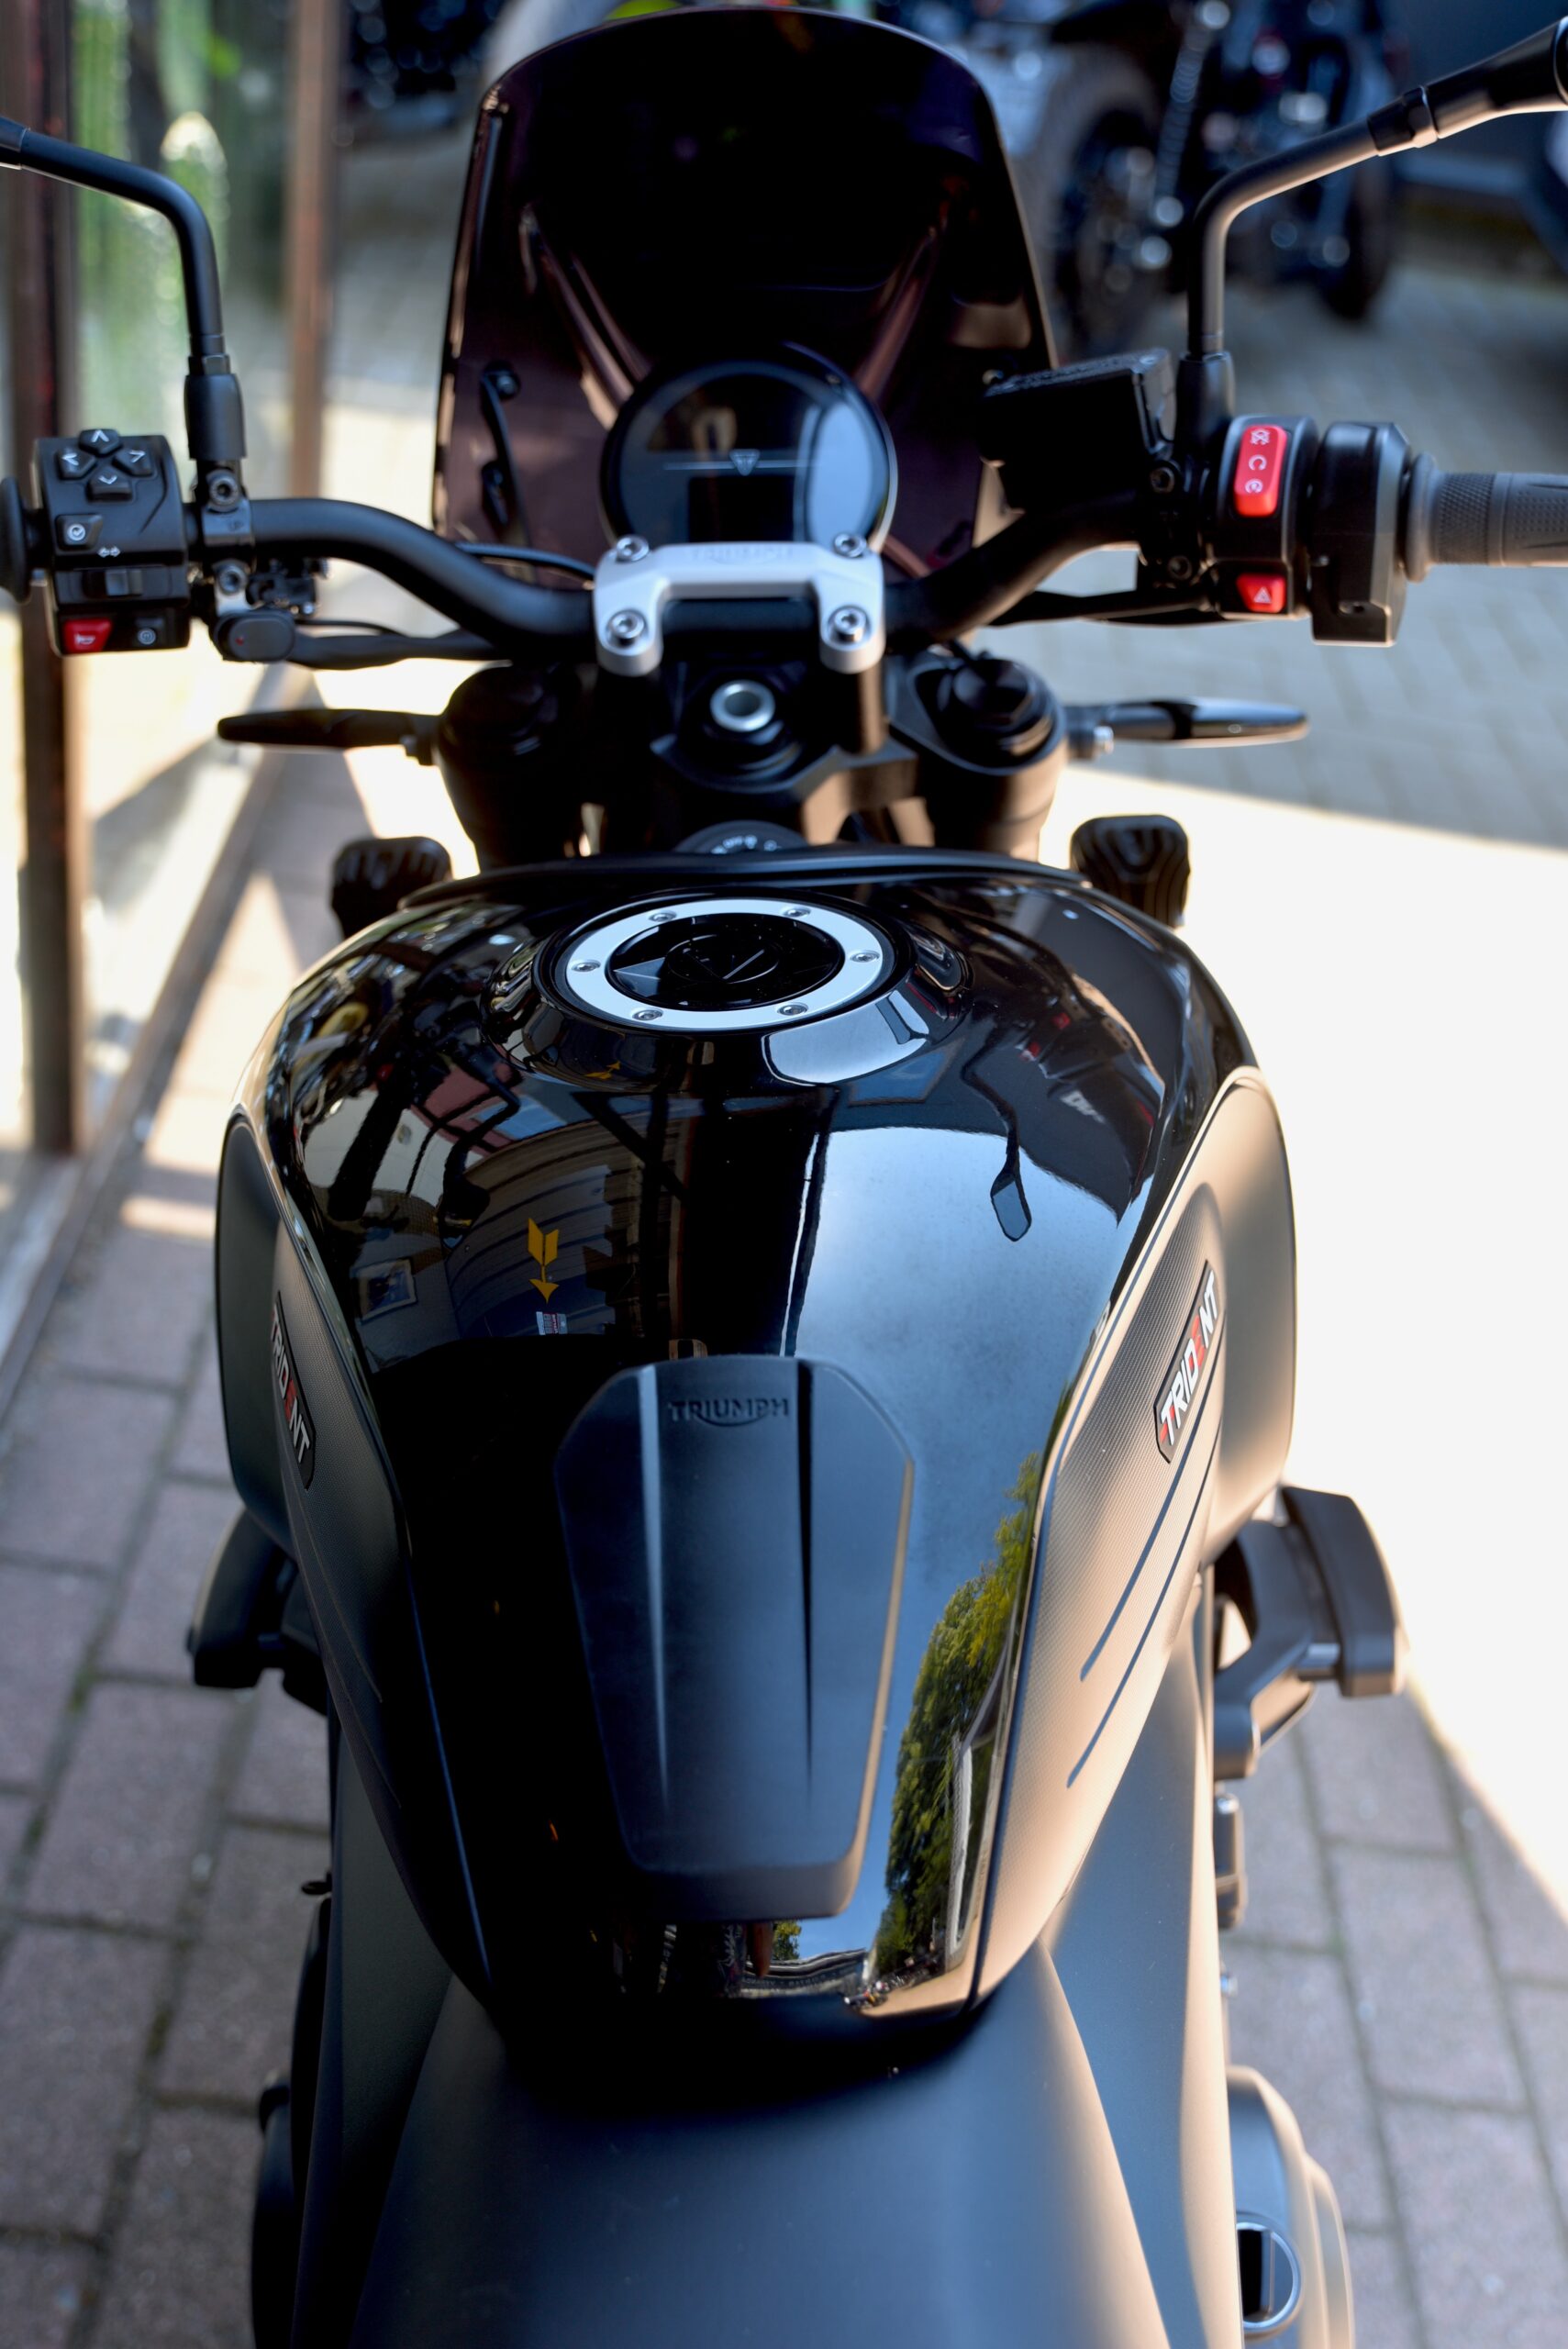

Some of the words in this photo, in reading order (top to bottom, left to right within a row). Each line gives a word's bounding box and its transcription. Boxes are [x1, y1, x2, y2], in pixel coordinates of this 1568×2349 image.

[270, 1303, 310, 1464] TRIDENT
[668, 1397, 790, 1427] TRIUMPH
[1160, 1269, 1218, 1447] TRIDENT
